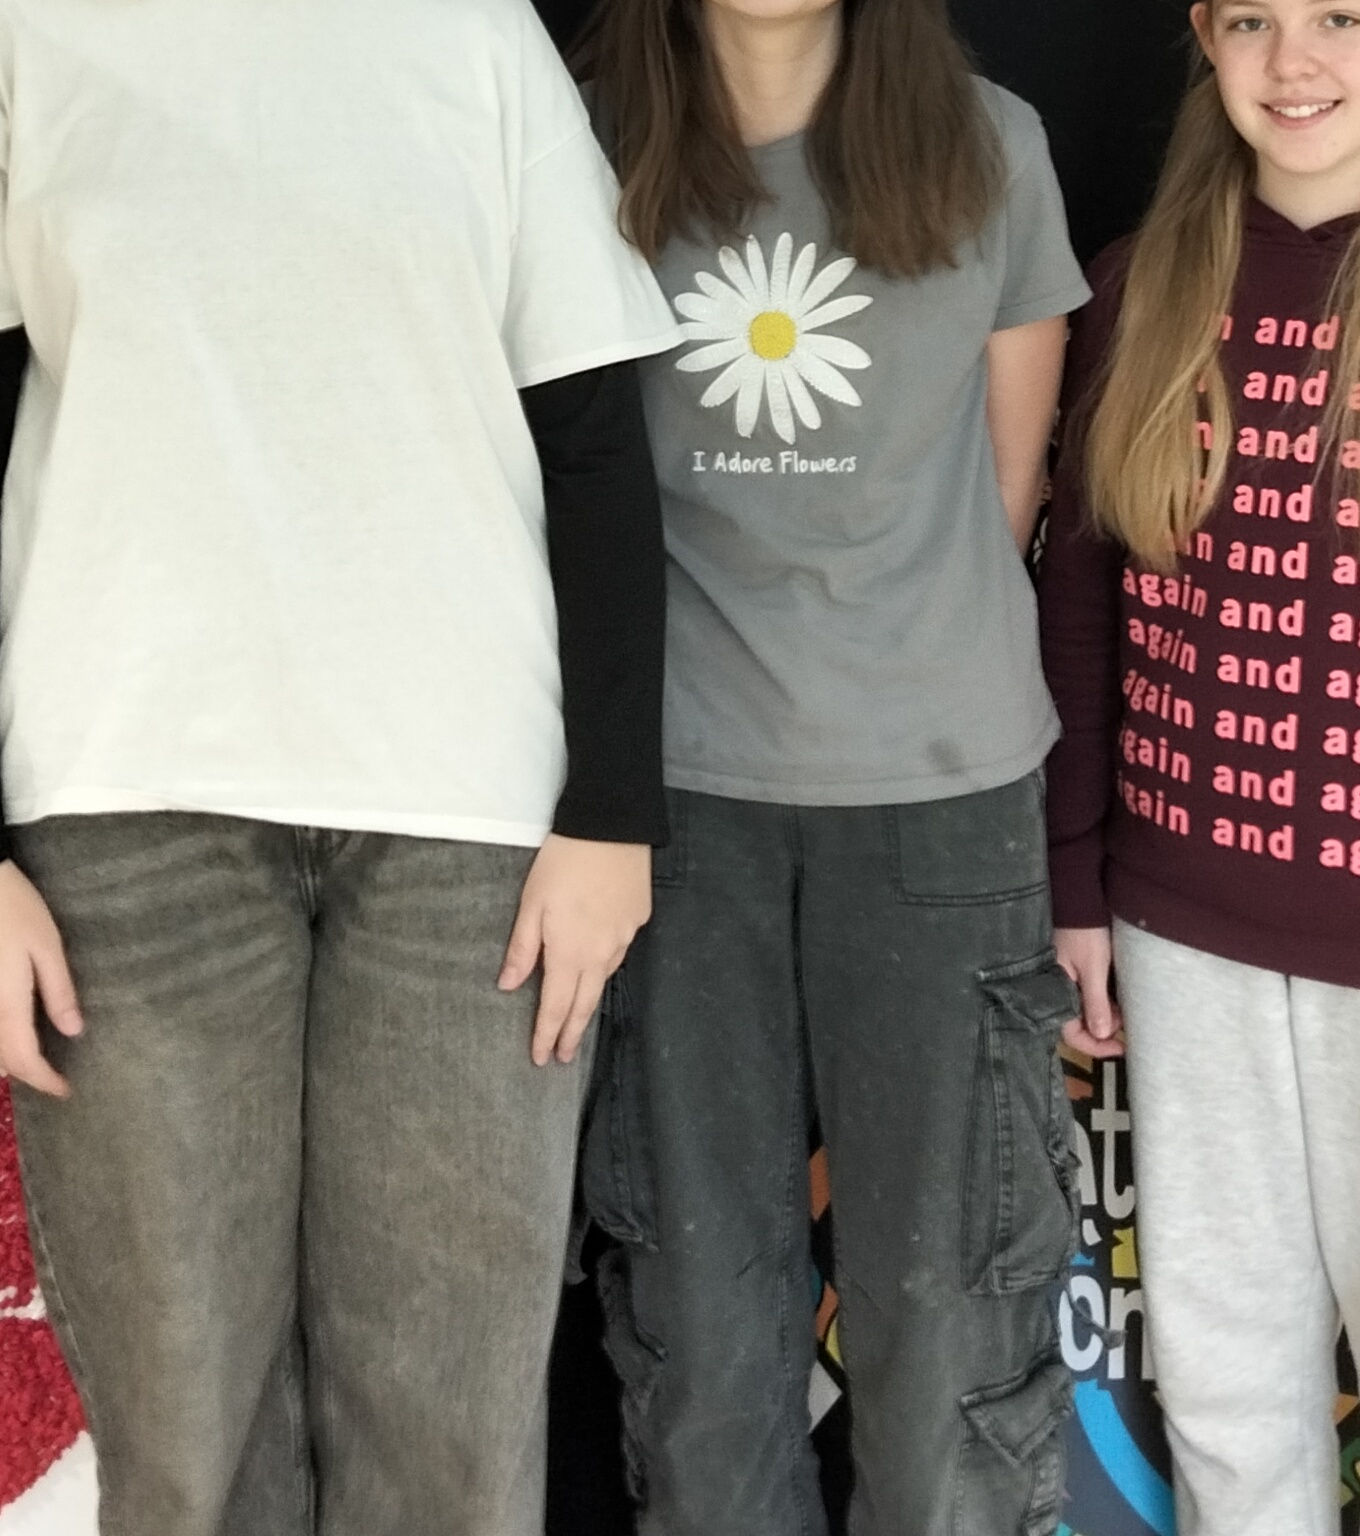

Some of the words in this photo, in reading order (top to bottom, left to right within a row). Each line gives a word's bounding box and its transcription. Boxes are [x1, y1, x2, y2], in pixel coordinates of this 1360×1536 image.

[1254, 314, 1340, 351] and
[1243, 369, 1329, 406] and
[693, 451, 706, 472] I
[714, 451, 774, 474] Adore
[779, 450, 858, 474] Flowers
[1236, 425, 1318, 463] and
[1233, 484, 1313, 522] and
[1227, 541, 1308, 580] and
[1122, 567, 1208, 618] again
[1219, 597, 1305, 637] and
[1127, 618, 1197, 674] again
[1216, 653, 1301, 694] and
[1122, 668, 1194, 729] again
[1214, 709, 1298, 751] and
[1119, 722, 1191, 784] gain
[1212, 764, 1296, 808] and
[1117, 770, 1190, 837] gain
[1211, 817, 1295, 862] and
